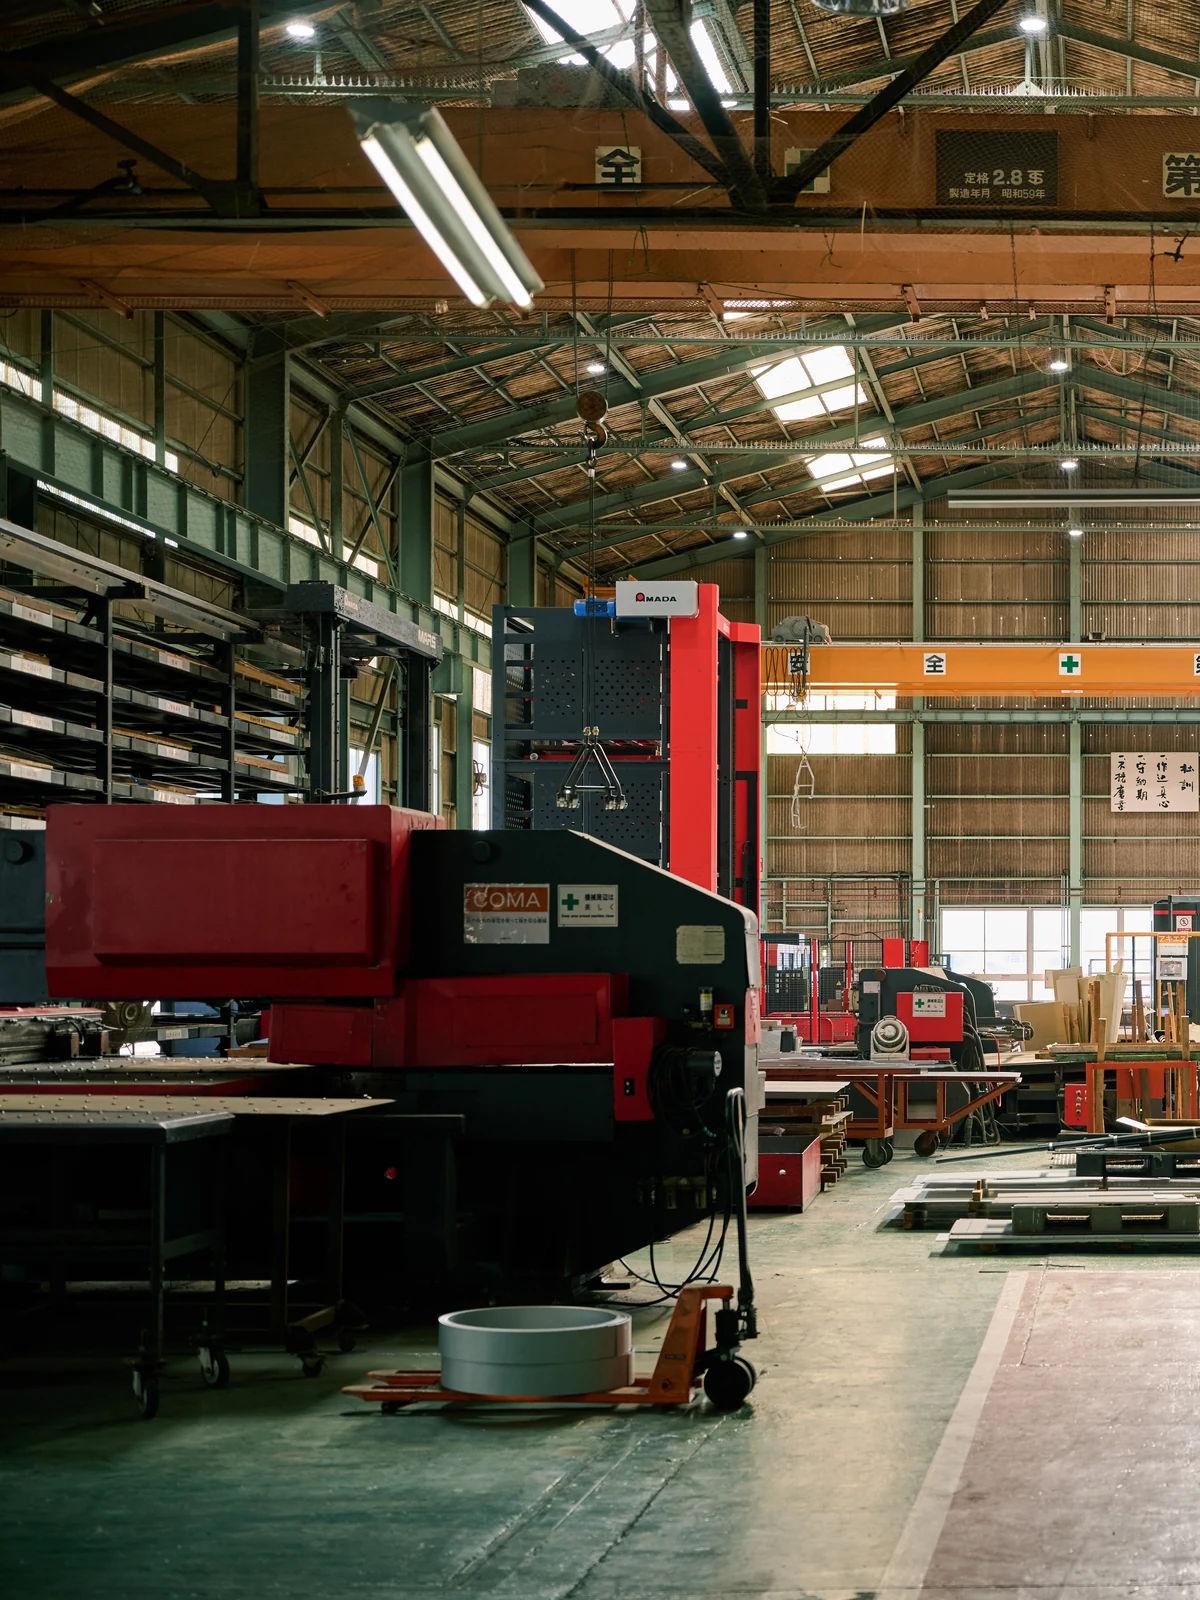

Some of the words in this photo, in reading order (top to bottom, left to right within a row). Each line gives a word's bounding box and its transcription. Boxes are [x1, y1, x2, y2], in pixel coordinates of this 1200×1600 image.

[597, 148, 641, 185] 全
[964, 172, 989, 184] 定格
[992, 169, 1023, 186] 2.8
[949, 188, 990, 199] 製造年月
[1001, 189, 1046, 199] 昭和59年
[635, 592, 677, 603] AMADA
[925, 654, 945, 674] 全
[473, 891, 541, 908] COMA
[1158, 935, 1187, 943] アキエス
